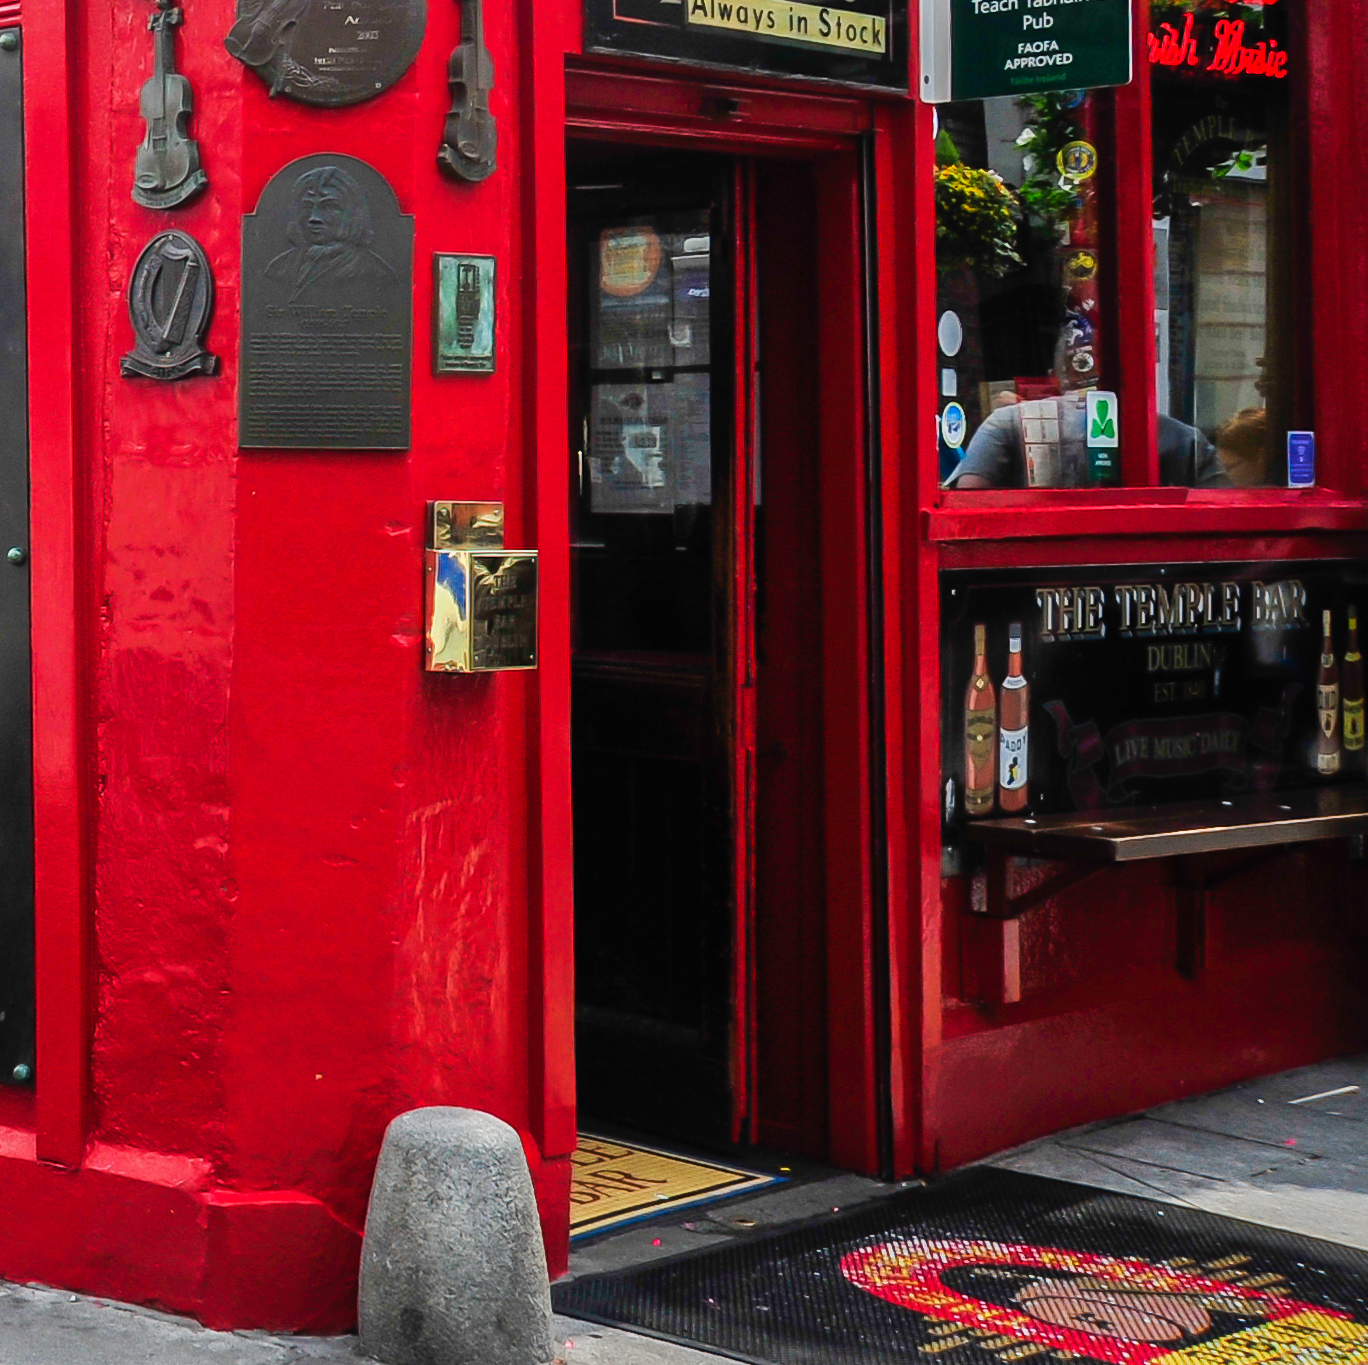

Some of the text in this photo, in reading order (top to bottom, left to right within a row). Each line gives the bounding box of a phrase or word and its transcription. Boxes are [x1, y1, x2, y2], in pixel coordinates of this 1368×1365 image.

[788, 7, 808, 36] in
[819, 7, 882, 48] Stock
[1022, 13, 1054, 31] Pub
[1017, 39, 1060, 55] FAOFA
[1147, 12, 1200, 67] rish
[1004, 52, 1073, 71] APPROVED
[1036, 580, 1310, 642] THE TEMPLE BAR
[1147, 643, 1212, 672] DUBLIN
[1115, 737, 1150, 767] LIVE
[1153, 736, 1197, 761] MUSIC
